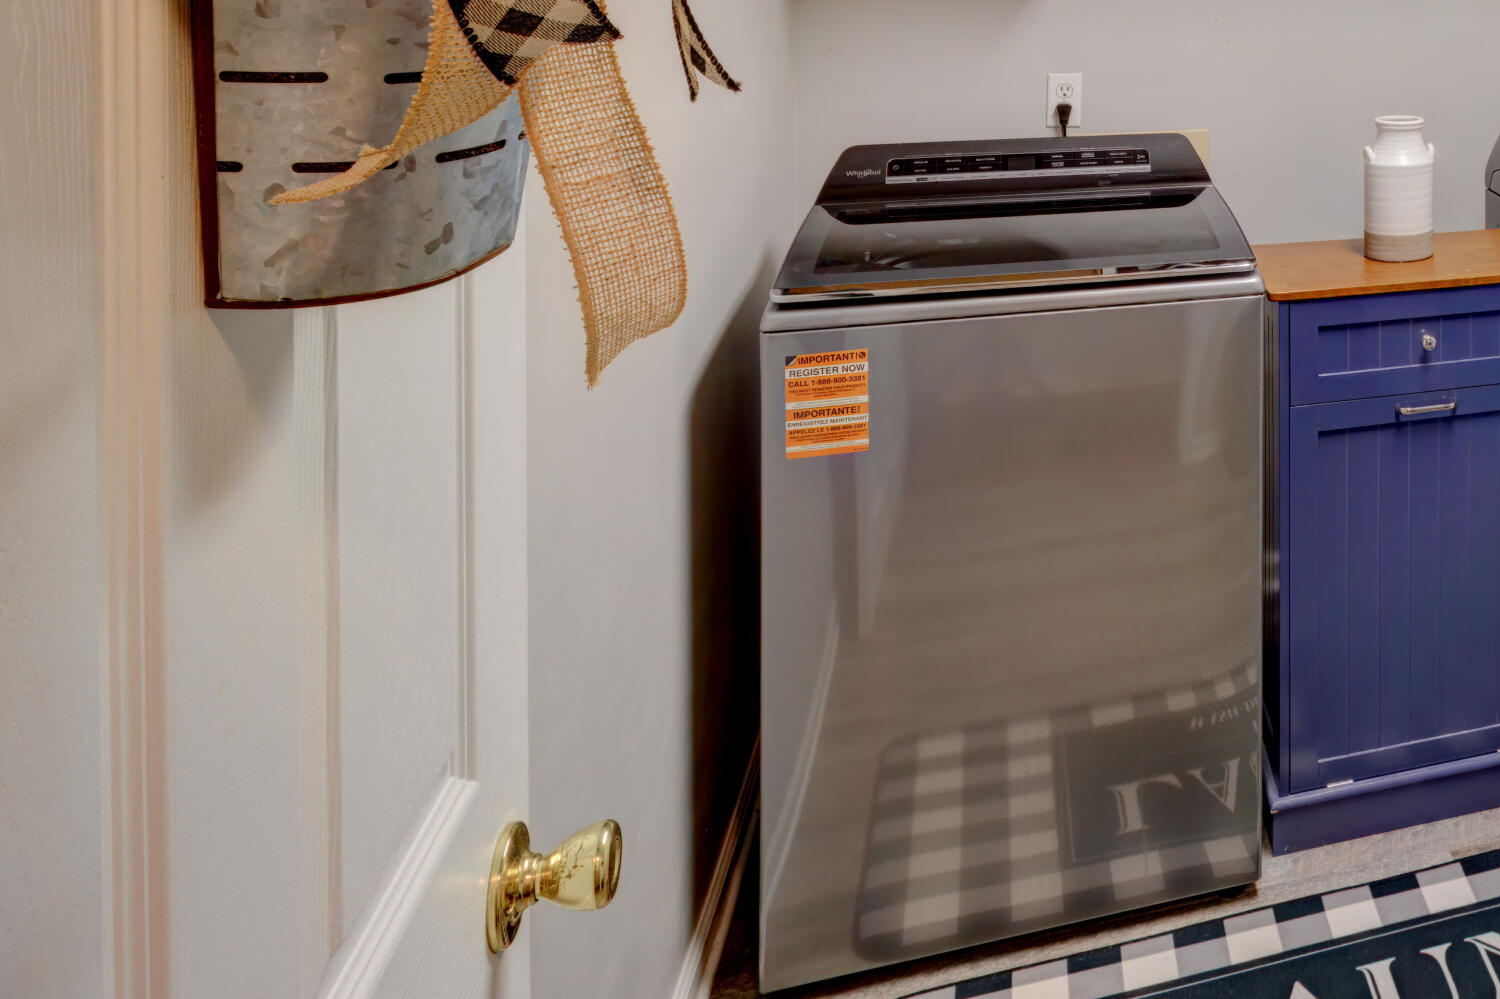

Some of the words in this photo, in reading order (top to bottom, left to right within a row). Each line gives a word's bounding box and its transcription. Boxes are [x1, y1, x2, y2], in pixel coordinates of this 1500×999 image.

[846, 169, 881, 178] Whirlpool
[798, 352, 857, 364] IMPORTANT!
[789, 367, 839, 378] REGISTER
[842, 364, 866, 372] NOW
[788, 380, 809, 388] CALL
[793, 406, 860, 419] IMPORTANTE!
